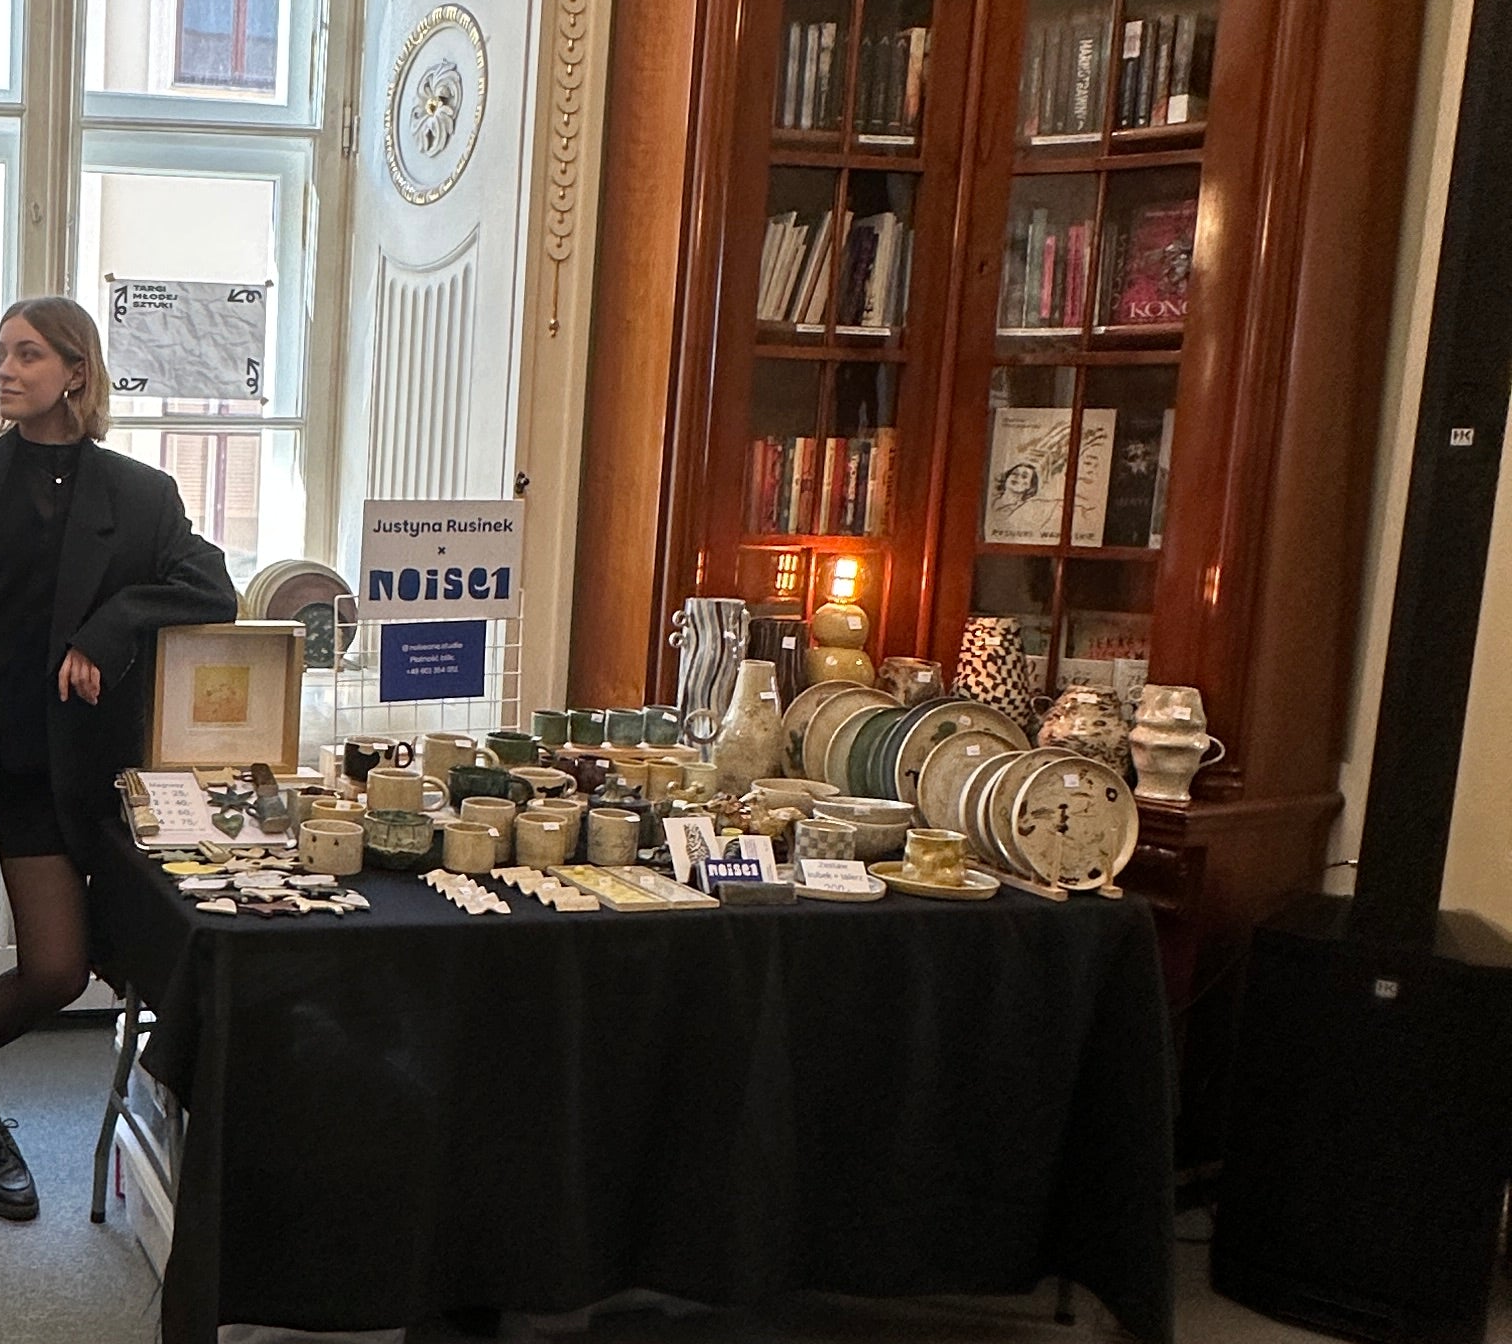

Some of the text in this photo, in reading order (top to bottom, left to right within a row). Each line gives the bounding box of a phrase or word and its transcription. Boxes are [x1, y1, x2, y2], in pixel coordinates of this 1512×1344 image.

[133, 301, 173, 309] SZTUKI
[373, 517, 513, 537] Justyna Rusinek
